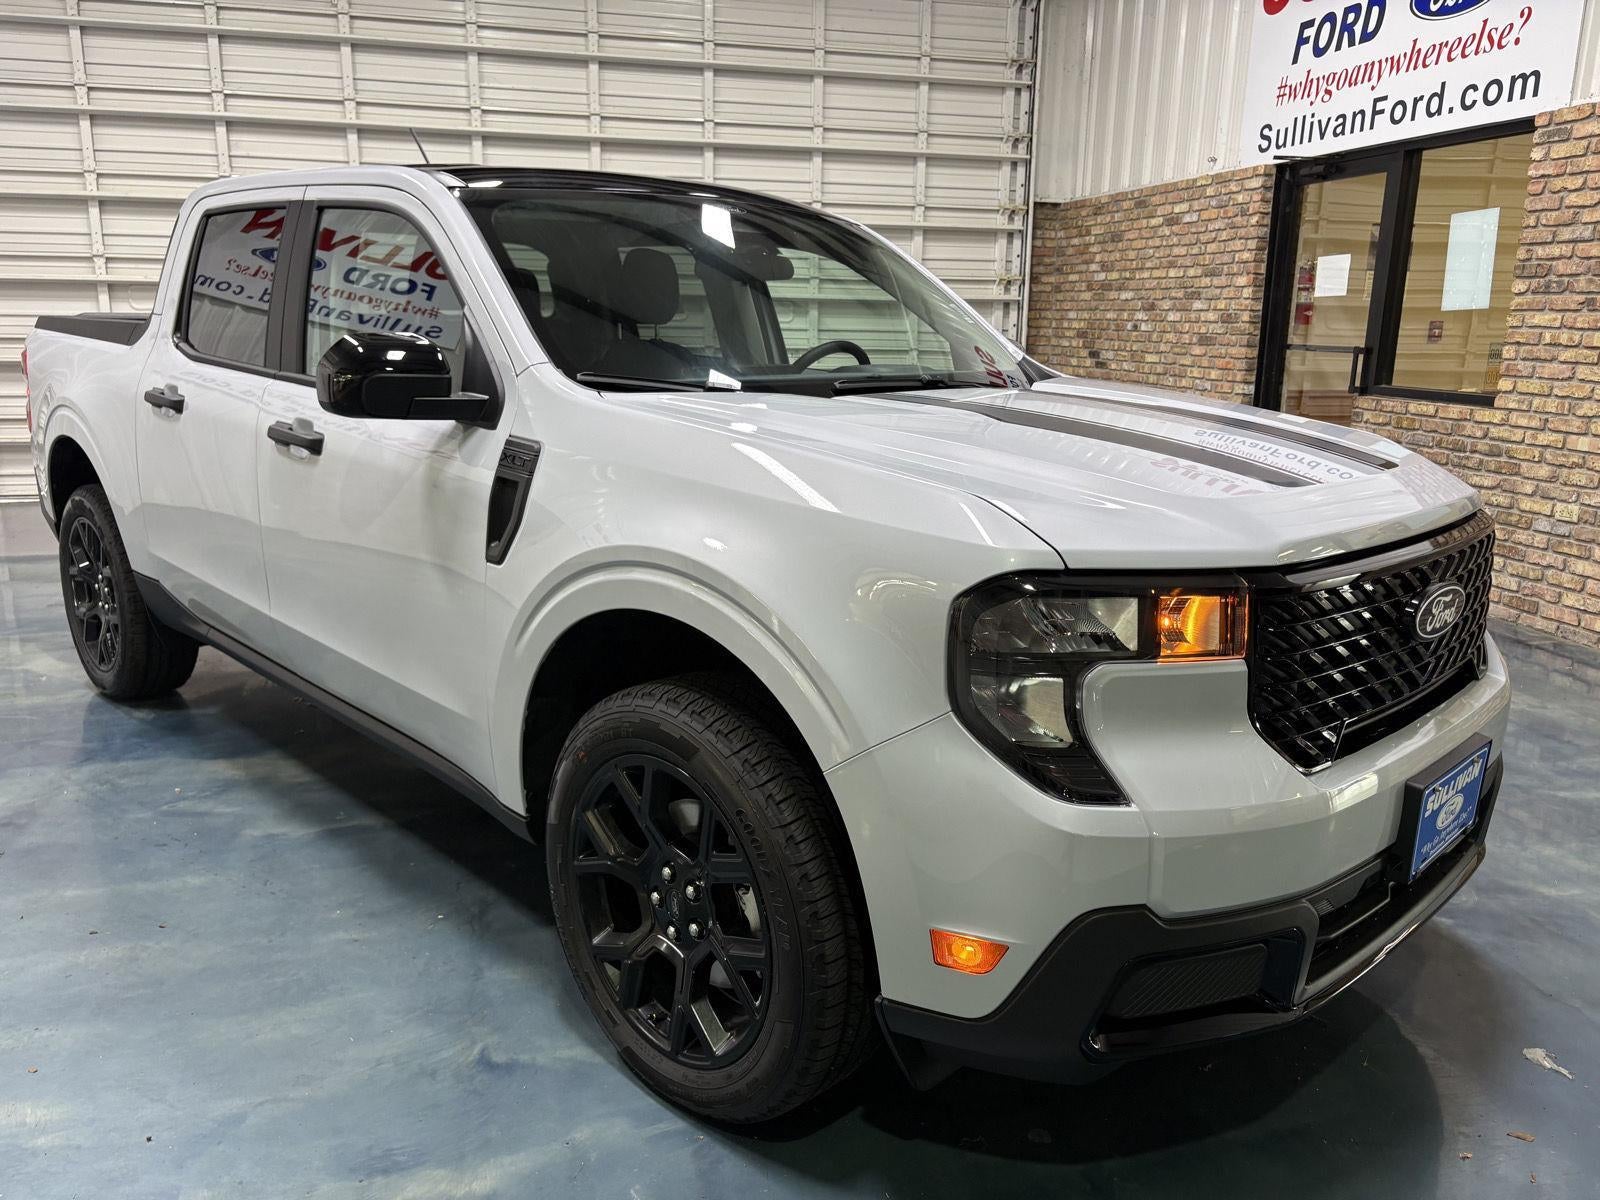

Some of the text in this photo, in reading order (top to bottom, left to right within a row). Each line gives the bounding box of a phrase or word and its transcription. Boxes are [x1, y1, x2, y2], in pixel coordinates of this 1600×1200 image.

[1275, 6, 1533, 107] #whygoanywhereelse?
[1291, 0, 1387, 66] FORD
[1257, 69, 1542, 154] SullivanFord.com
[500, 452, 531, 468] XLT
[1426, 593, 1459, 633] Ford
[1424, 758, 1483, 818] SULLIVAN
